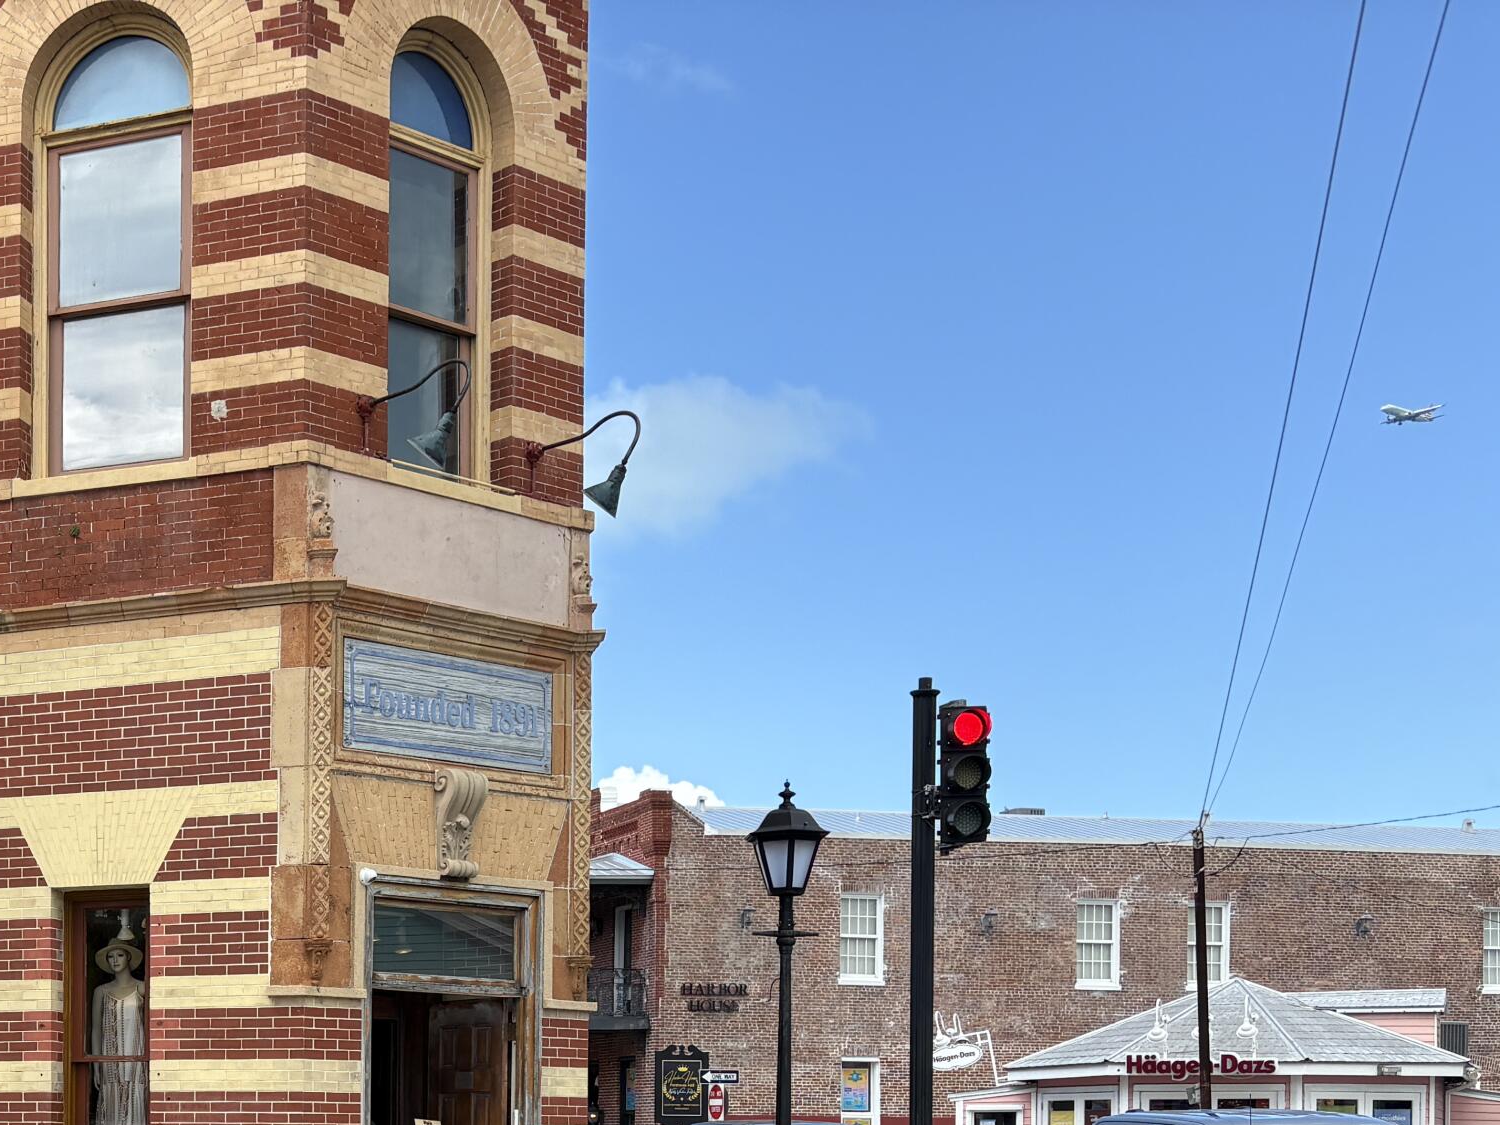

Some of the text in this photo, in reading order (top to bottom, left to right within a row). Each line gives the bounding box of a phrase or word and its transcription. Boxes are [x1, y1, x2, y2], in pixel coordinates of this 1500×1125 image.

[361, 677, 539, 738] Founded 1891
[681, 982, 748, 996] HARBOR
[687, 1000, 739, 1013] HOUSE
